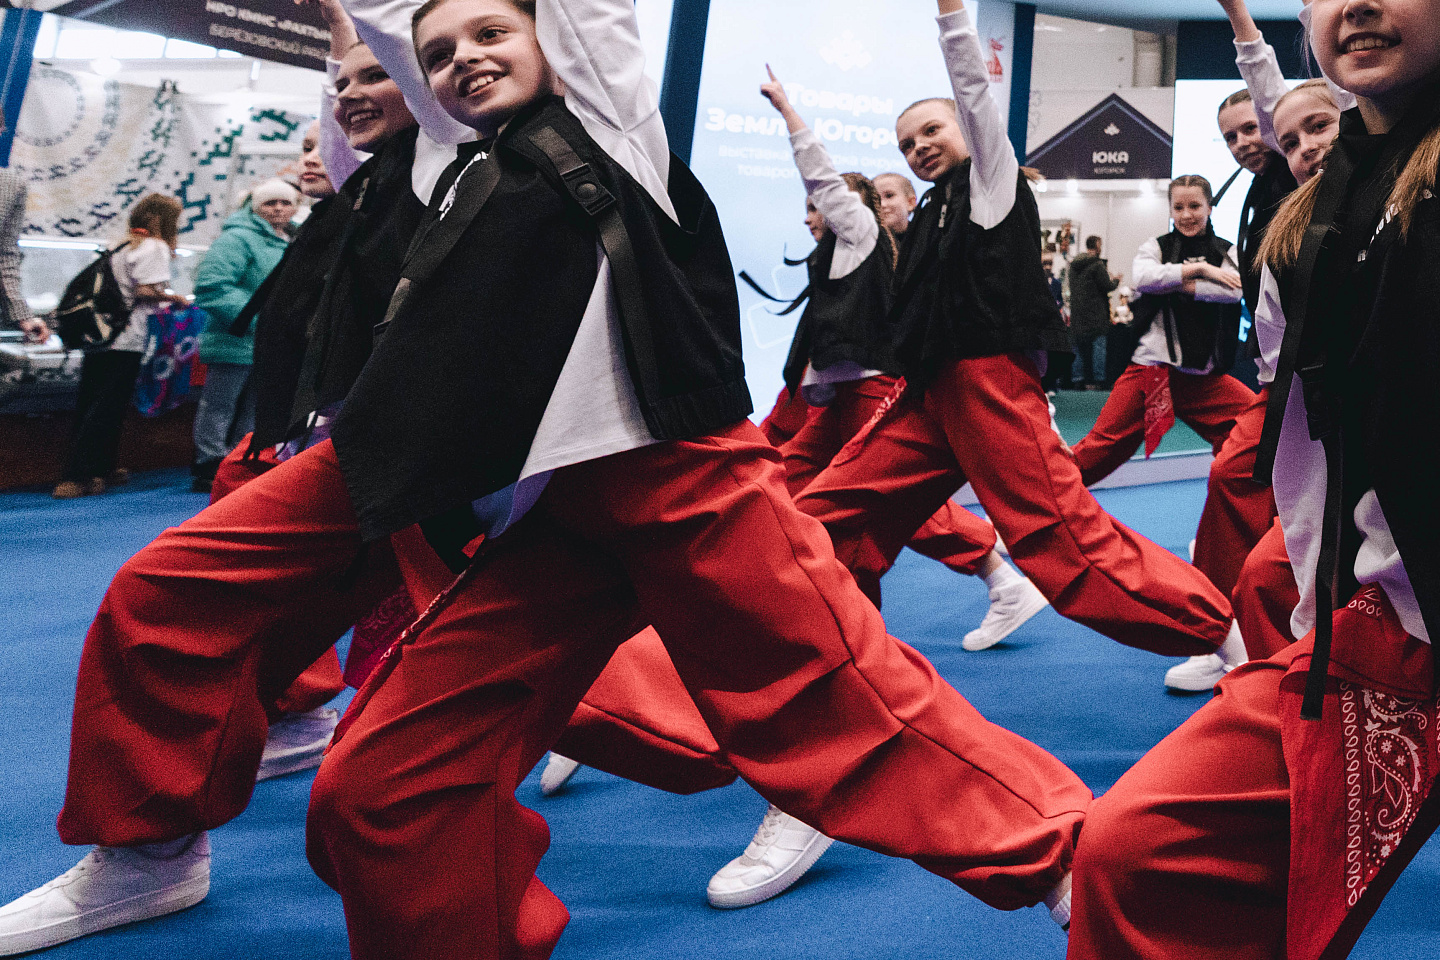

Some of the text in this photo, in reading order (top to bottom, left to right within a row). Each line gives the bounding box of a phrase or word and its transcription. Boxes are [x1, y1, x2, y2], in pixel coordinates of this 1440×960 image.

[783, 82, 894, 117] Товары
[704, 106, 788, 137] Земл
[1092, 151, 1129, 164] ЮКА
